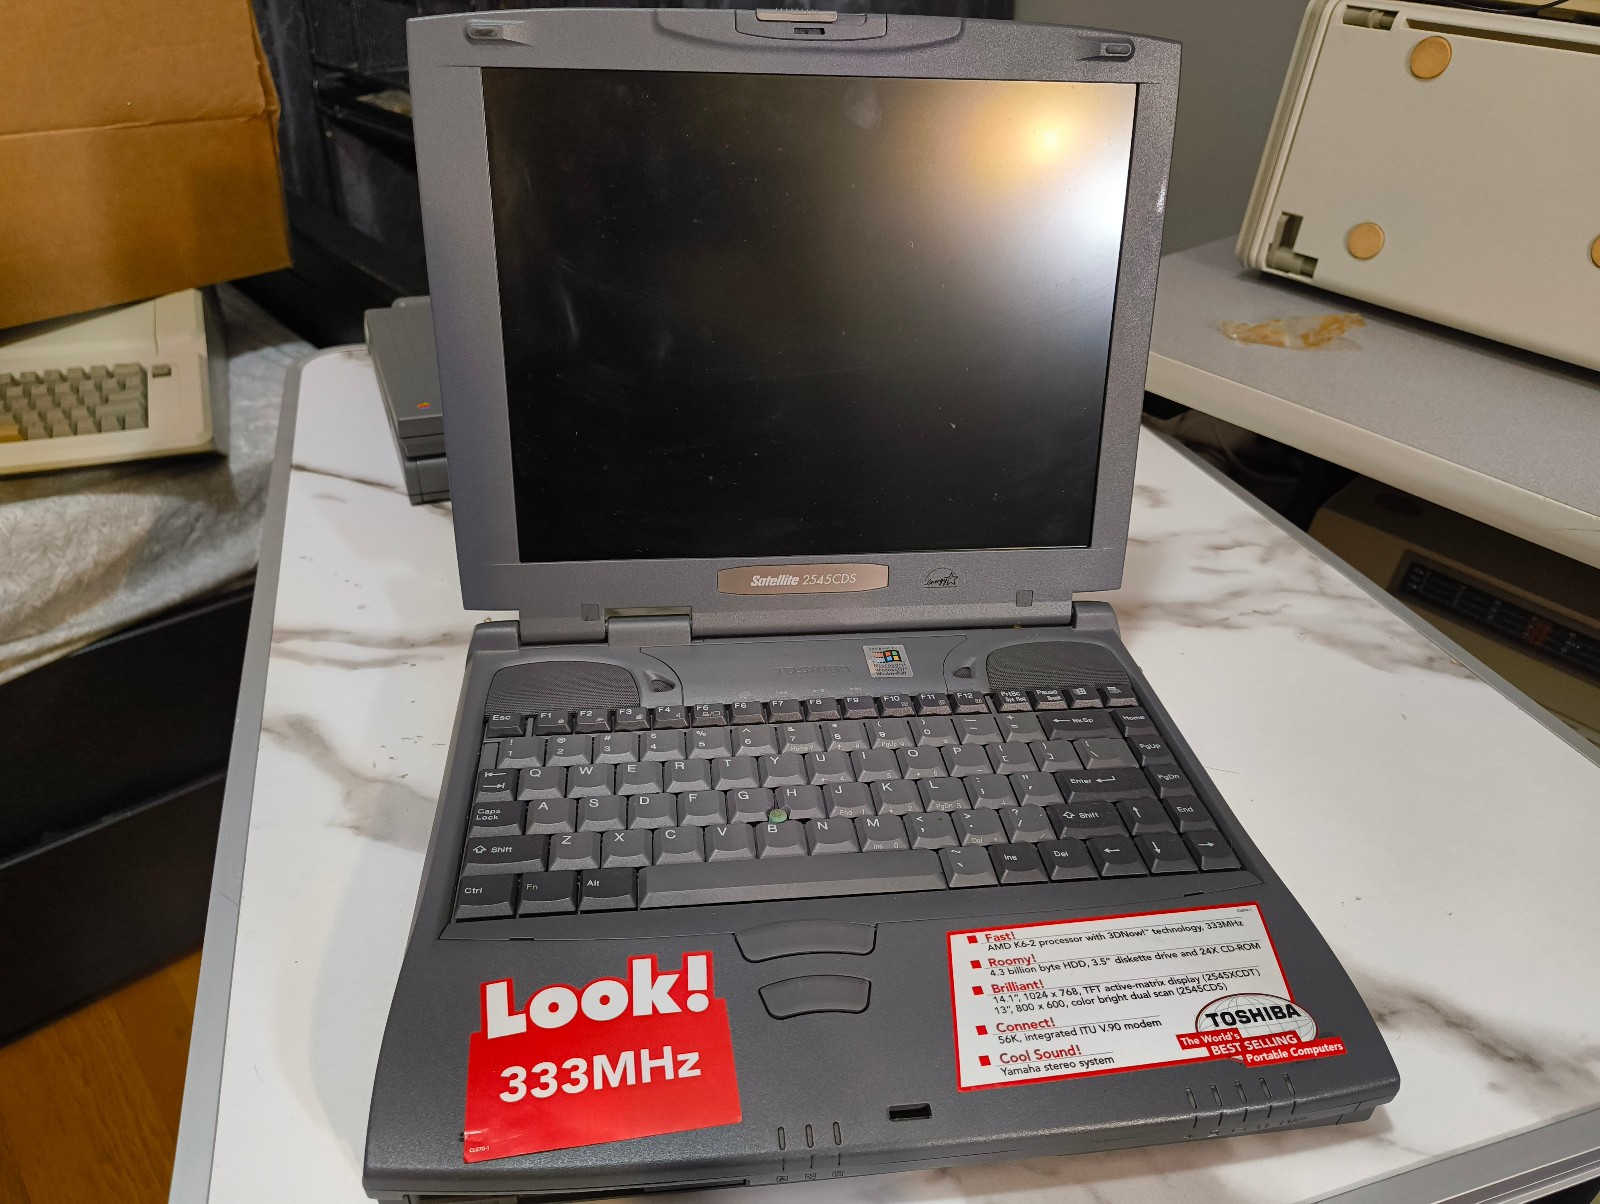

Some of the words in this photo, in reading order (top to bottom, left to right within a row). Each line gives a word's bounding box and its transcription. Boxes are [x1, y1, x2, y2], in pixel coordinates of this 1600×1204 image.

[751, 575, 800, 587] Satellite
[802, 573, 857, 585] 2545CDS
[861, 751, 866, 760] I
[907, 749, 919, 757] O
[952, 747, 962, 755] P
[769, 756, 780, 765] Y
[815, 753, 826, 762] U
[675, 761, 685, 770] R
[723, 759, 732, 767] T
[529, 768, 542, 777] Q
[578, 766, 594, 775] W
[627, 764, 637, 773] E
[1069, 777, 1092, 785] Enter
[1157, 774, 1180, 782] PgDn
[882, 782, 893, 792] K
[929, 780, 939, 789] L
[786, 788, 798, 797] H
[834, 786, 843, 794] J
[688, 793, 698, 803] F
[737, 791, 750, 800] G
[588, 799, 599, 808] S
[639, 796, 650, 805] D
[538, 802, 549, 810] A
[477, 808, 501, 816] Caps
[817, 821, 828, 830] N
[866, 818, 880, 827] M
[717, 827, 728, 836] V
[767, 824, 778, 833] B
[614, 832, 625, 842] X
[665, 829, 676, 839] C
[562, 835, 572, 845] Z
[1053, 850, 1069, 858] Del
[984, 931, 1017, 943] Fast!
[987, 941, 1012, 951] AMD
[1014, 939, 1037, 949] K6-2
[1039, 936, 1083, 948] processor
[1085, 932, 1106, 942] with
[1151, 924, 1205, 936] technology,
[1206, 920, 1244, 930] 333MHz
[988, 953, 1038, 968] Roomy!
[990, 967, 1005, 977] 4.3
[1008, 964, 1037, 975] billion
[1038, 961, 1061, 973] byte
[1062, 958, 1090, 969] HDD,
[1114, 953, 1152, 965] diskette
[1154, 950, 1178, 960] drive
[1180, 949, 1199, 958] and
[1200, 947, 1219, 956] 24X
[1220, 942, 1262, 953] CD-ROM
[990, 979, 1045, 994] Brilliant!
[1023, 990, 1049, 1001] 1024
[1059, 987, 1082, 997] 768,
[1082, 985, 1101, 995] TFT
[1104, 980, 1166, 992] active-matrix
[1168, 975, 1204, 987] display
[1202, 968, 1261, 983] (2545XCDT)
[485, 954, 710, 1040] Look!
[1015, 1003, 1035, 1013] 800
[1046, 1000, 1069, 1009] 600,
[1071, 997, 1095, 1007] color
[1099, 993, 1128, 1006] bright
[1130, 989, 1151, 1000] dual
[1154, 989, 1175, 998] scan
[1176, 982, 1228, 997] (2545CDS)
[1205, 1003, 1302, 1028] TOSHIBA
[996, 1017, 1056, 1034] Connect!
[998, 1034, 1022, 1045] 56K,
[1024, 1027, 1078, 1043] integrated
[1079, 1025, 1097, 1036] ITU
[1098, 1023, 1122, 1033] V.90
[1124, 1019, 1163, 1031] modem
[1180, 1036, 1200, 1046] The
[1200, 1032, 1241, 1045] World's
[1211, 1042, 1242, 1056] BEST
[1244, 1033, 1298, 1051] SELLING
[999, 1049, 1030, 1065] Cool
[1034, 1044, 1082, 1060] Sound!
[1245, 1049, 1289, 1063] Portable
[1289, 1042, 1344, 1057] Computers
[1000, 1064, 1041, 1077] Yamaha
[1043, 1060, 1077, 1072] stereo
[1078, 1055, 1115, 1069] system
[499, 1045, 701, 1103] 333MHz
